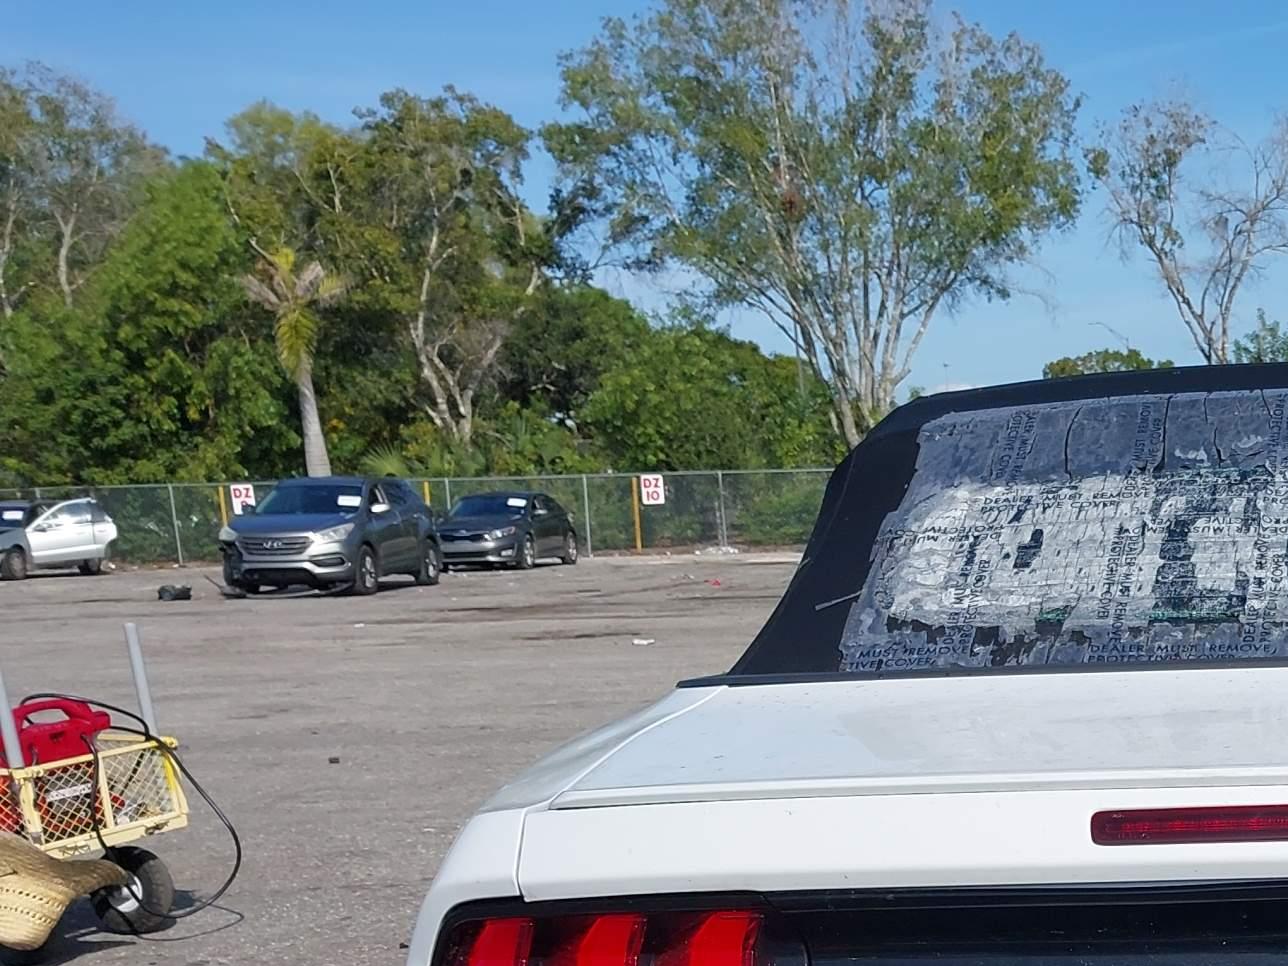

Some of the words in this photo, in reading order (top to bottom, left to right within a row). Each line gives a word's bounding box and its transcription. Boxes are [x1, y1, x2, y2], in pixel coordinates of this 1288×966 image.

[1136, 400, 1152, 434] REMOV
[642, 477, 661, 489] DZ
[232, 487, 252, 498] DZ
[646, 490, 660, 501] 10
[1092, 490, 1150, 500] REMOVE
[1118, 573, 1133, 598] MUST
[857, 648, 900, 659] MUST
[908, 645, 968, 657] REMOVE
[1089, 644, 1146, 653] DEALER
[1156, 643, 1198, 653] MUST
[1209, 643, 1271, 653] REMOVE
